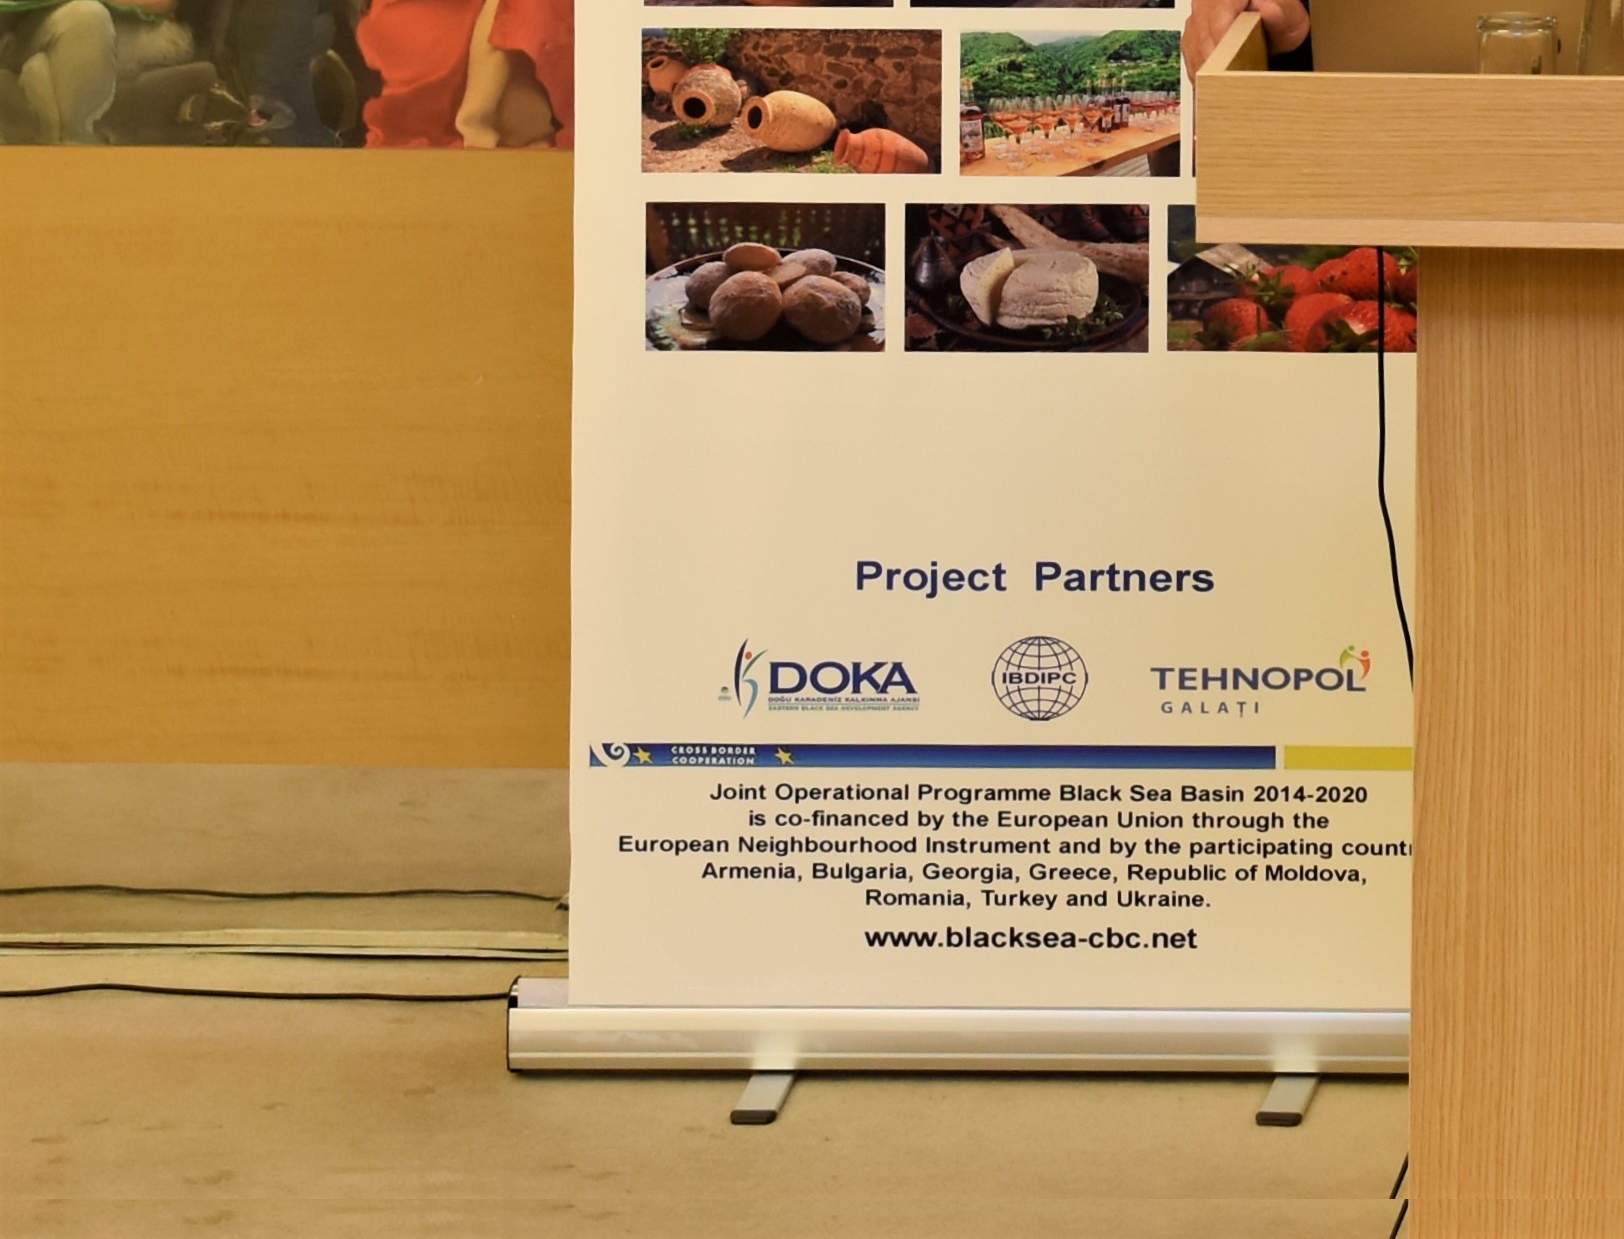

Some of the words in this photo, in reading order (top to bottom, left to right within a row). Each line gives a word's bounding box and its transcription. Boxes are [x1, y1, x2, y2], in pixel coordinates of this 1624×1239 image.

[856, 560, 1008, 599] Project
[1035, 561, 1215, 593] Partners
[768, 661, 919, 694] DOKA
[1001, 670, 1077, 686] IBDIPC
[1150, 666, 1367, 692] TEHNOPOL
[1160, 701, 1259, 718] GALAȚI
[671, 746, 708, 755] CROSS
[711, 746, 756, 755] BORDER
[672, 756, 755, 765] COOPERATION
[709, 783, 767, 801] Joint
[774, 782, 910, 805] Operational
[917, 783, 1052, 805] Programme
[1059, 784, 1122, 802] Black
[1129, 784, 1172, 803] Sea
[1180, 785, 1245, 803] Basin
[1253, 785, 1368, 804] 2014-2020
[748, 809, 767, 827] is
[774, 809, 909, 827] co-financed
[917, 810, 945, 832] by
[952, 810, 989, 828] the
[997, 810, 1108, 832] European
[1117, 811, 1184, 829] Union
[1191, 811, 1285, 833] through
[1292, 811, 1330, 829] the
[618, 835, 729, 857] European
[738, 835, 917, 857] Neighbourhood
[926, 836, 1051, 854] Instrument
[1058, 837, 1101, 855] and
[1109, 837, 1138, 859] by
[1144, 837, 1182, 855] the
[1189, 836, 1333, 860] participating
[701, 862, 803, 883] Armenia,
[812, 862, 914, 884] Bulgaria,
[922, 862, 1020, 885] Georgia,
[1029, 862, 1118, 884] Greece,
[1127, 863, 1227, 885] Republic
[1234, 864, 1259, 882] of
[1265, 863, 1367, 886] Moldova,
[865, 888, 971, 910] Romania,
[980, 889, 1058, 911] Turkey
[1066, 890, 1108, 907] and
[1117, 890, 1211, 908] Ukraine.
[864, 926, 1198, 950] www.blacksea-cbc.net
